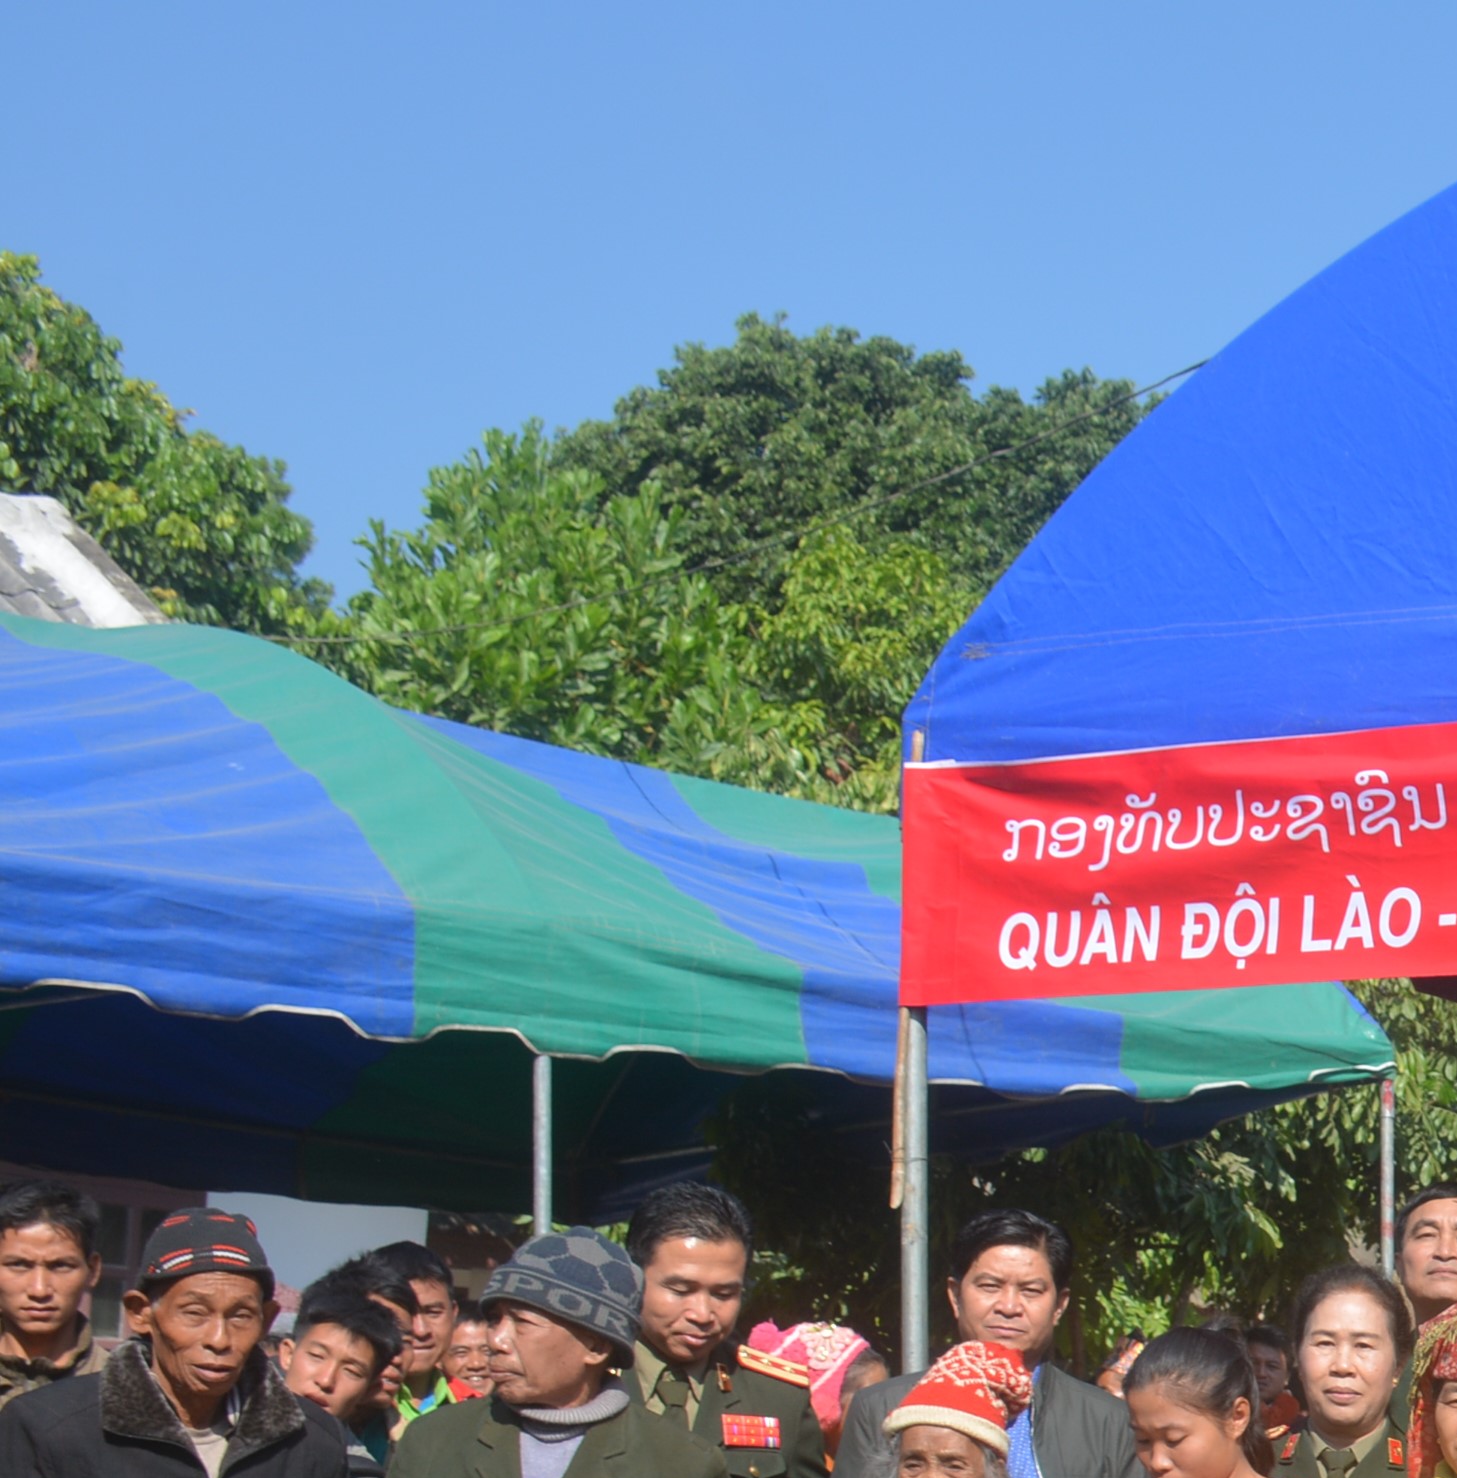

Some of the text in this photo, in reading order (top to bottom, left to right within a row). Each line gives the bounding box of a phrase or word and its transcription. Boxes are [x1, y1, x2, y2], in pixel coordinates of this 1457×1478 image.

[998, 892, 1160, 971] QUÂN
[1181, 882, 1281, 969] ĐỘI
[1300, 875, 1422, 953] LÀO
